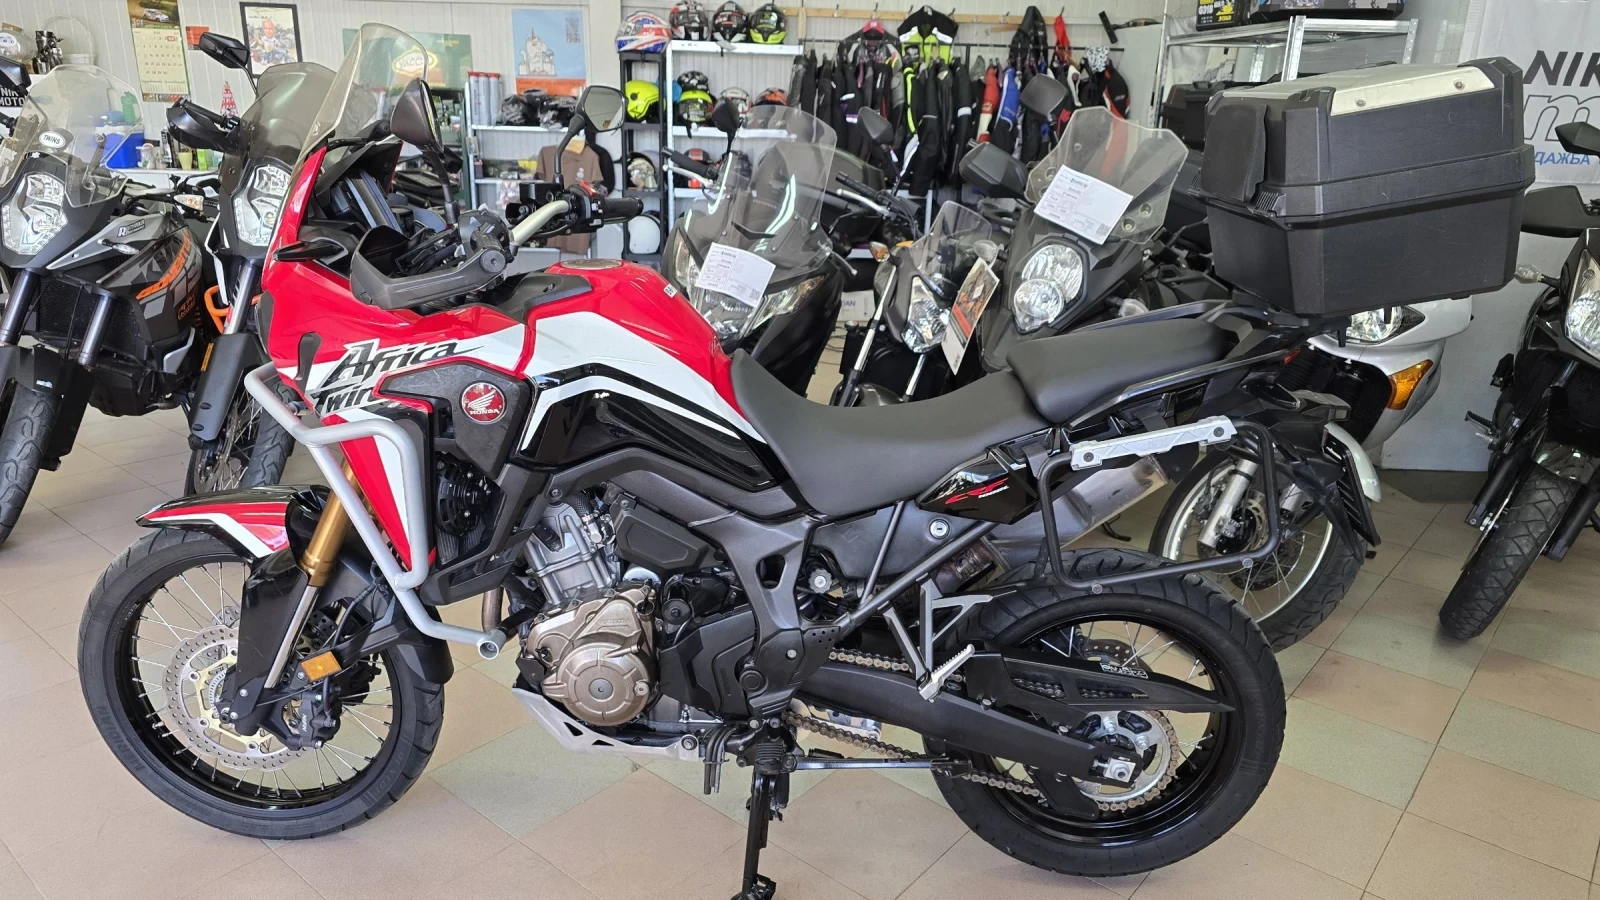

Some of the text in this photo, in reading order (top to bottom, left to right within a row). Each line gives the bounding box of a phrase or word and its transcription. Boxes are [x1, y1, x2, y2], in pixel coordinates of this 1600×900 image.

[43, 134, 61, 145] TWINS
[321, 341, 484, 389] Africa
[469, 408, 500, 416] HONDA
[96, 704, 147, 772] MERIDIAN
